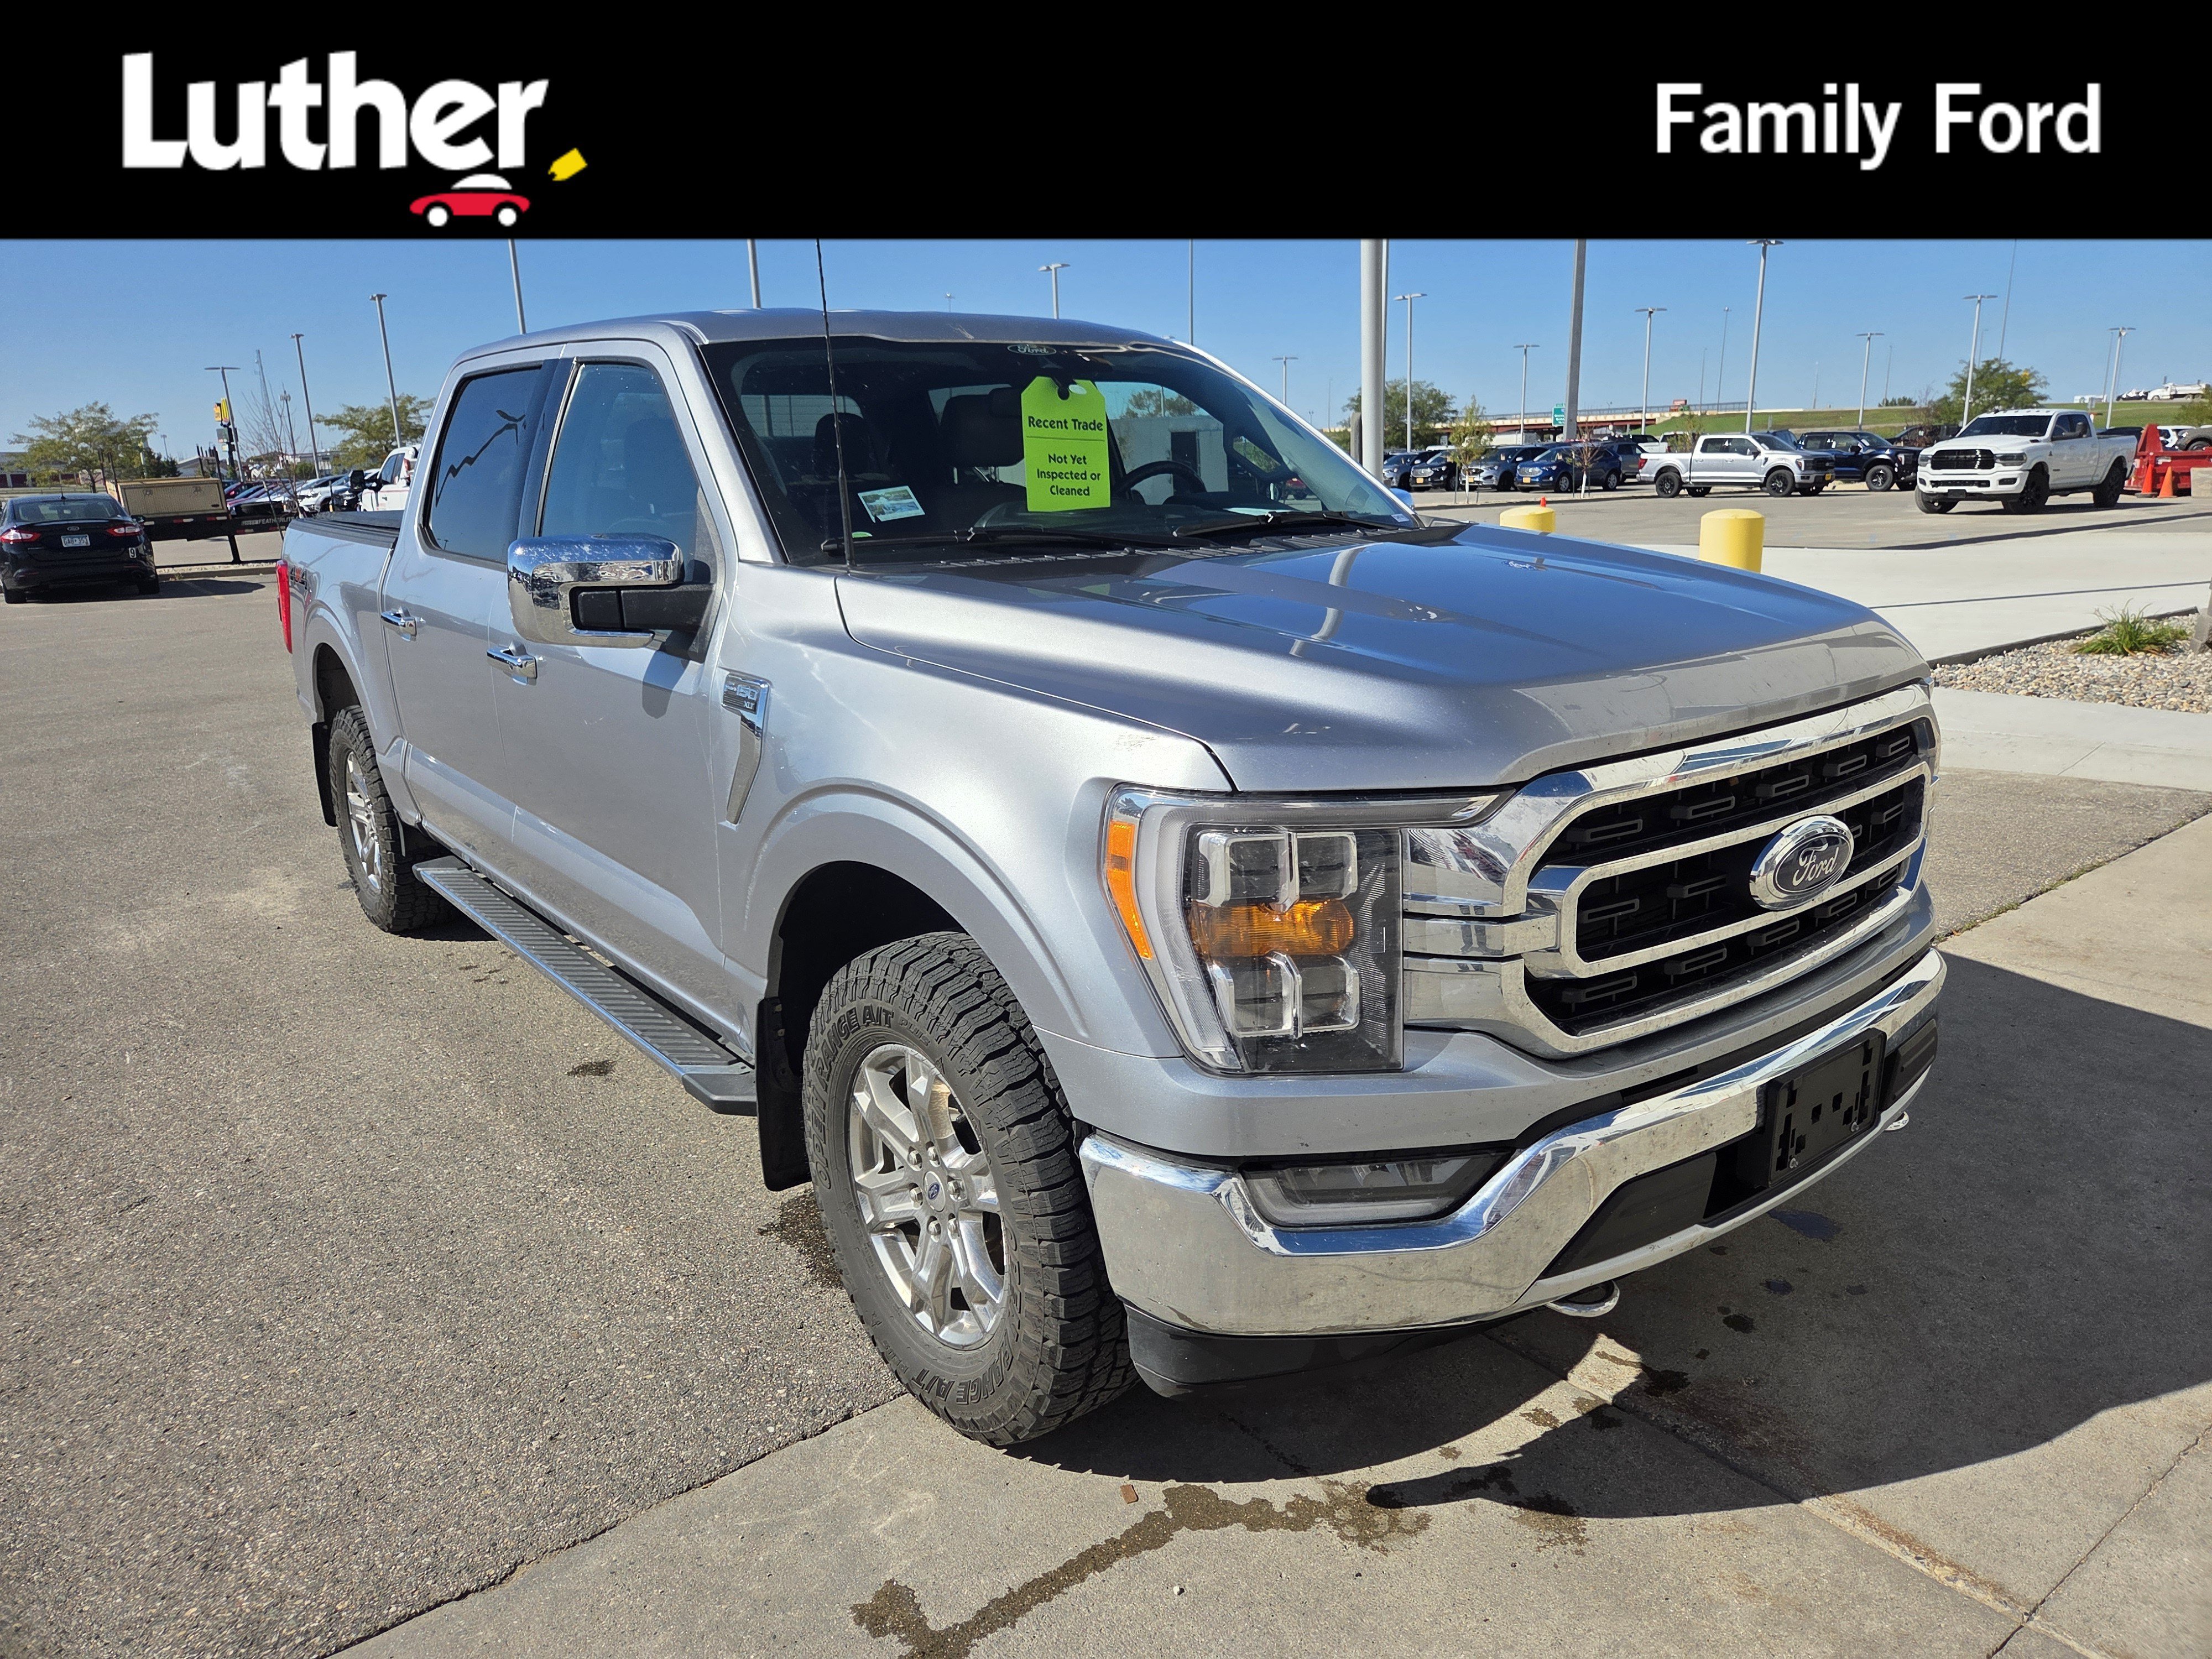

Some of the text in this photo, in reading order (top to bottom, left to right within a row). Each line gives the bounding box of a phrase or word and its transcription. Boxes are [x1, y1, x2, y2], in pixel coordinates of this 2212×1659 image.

[1027, 416, 1103, 431] Recent Trade
[1048, 453, 1087, 465] Not Yet
[1037, 468, 1101, 482] Inspected or
[1050, 485, 1090, 496] Cleaned
[130, 548, 135, 557] 9
[743, 701, 755, 709] XLT
[1792, 837, 1839, 886] Ford
[898, 1016, 931, 1046] PLUS
[815, 1006, 861, 1092] RANGE
[811, 1084, 831, 1190] OPEN
[956, 1328, 1014, 1405] RANGE
